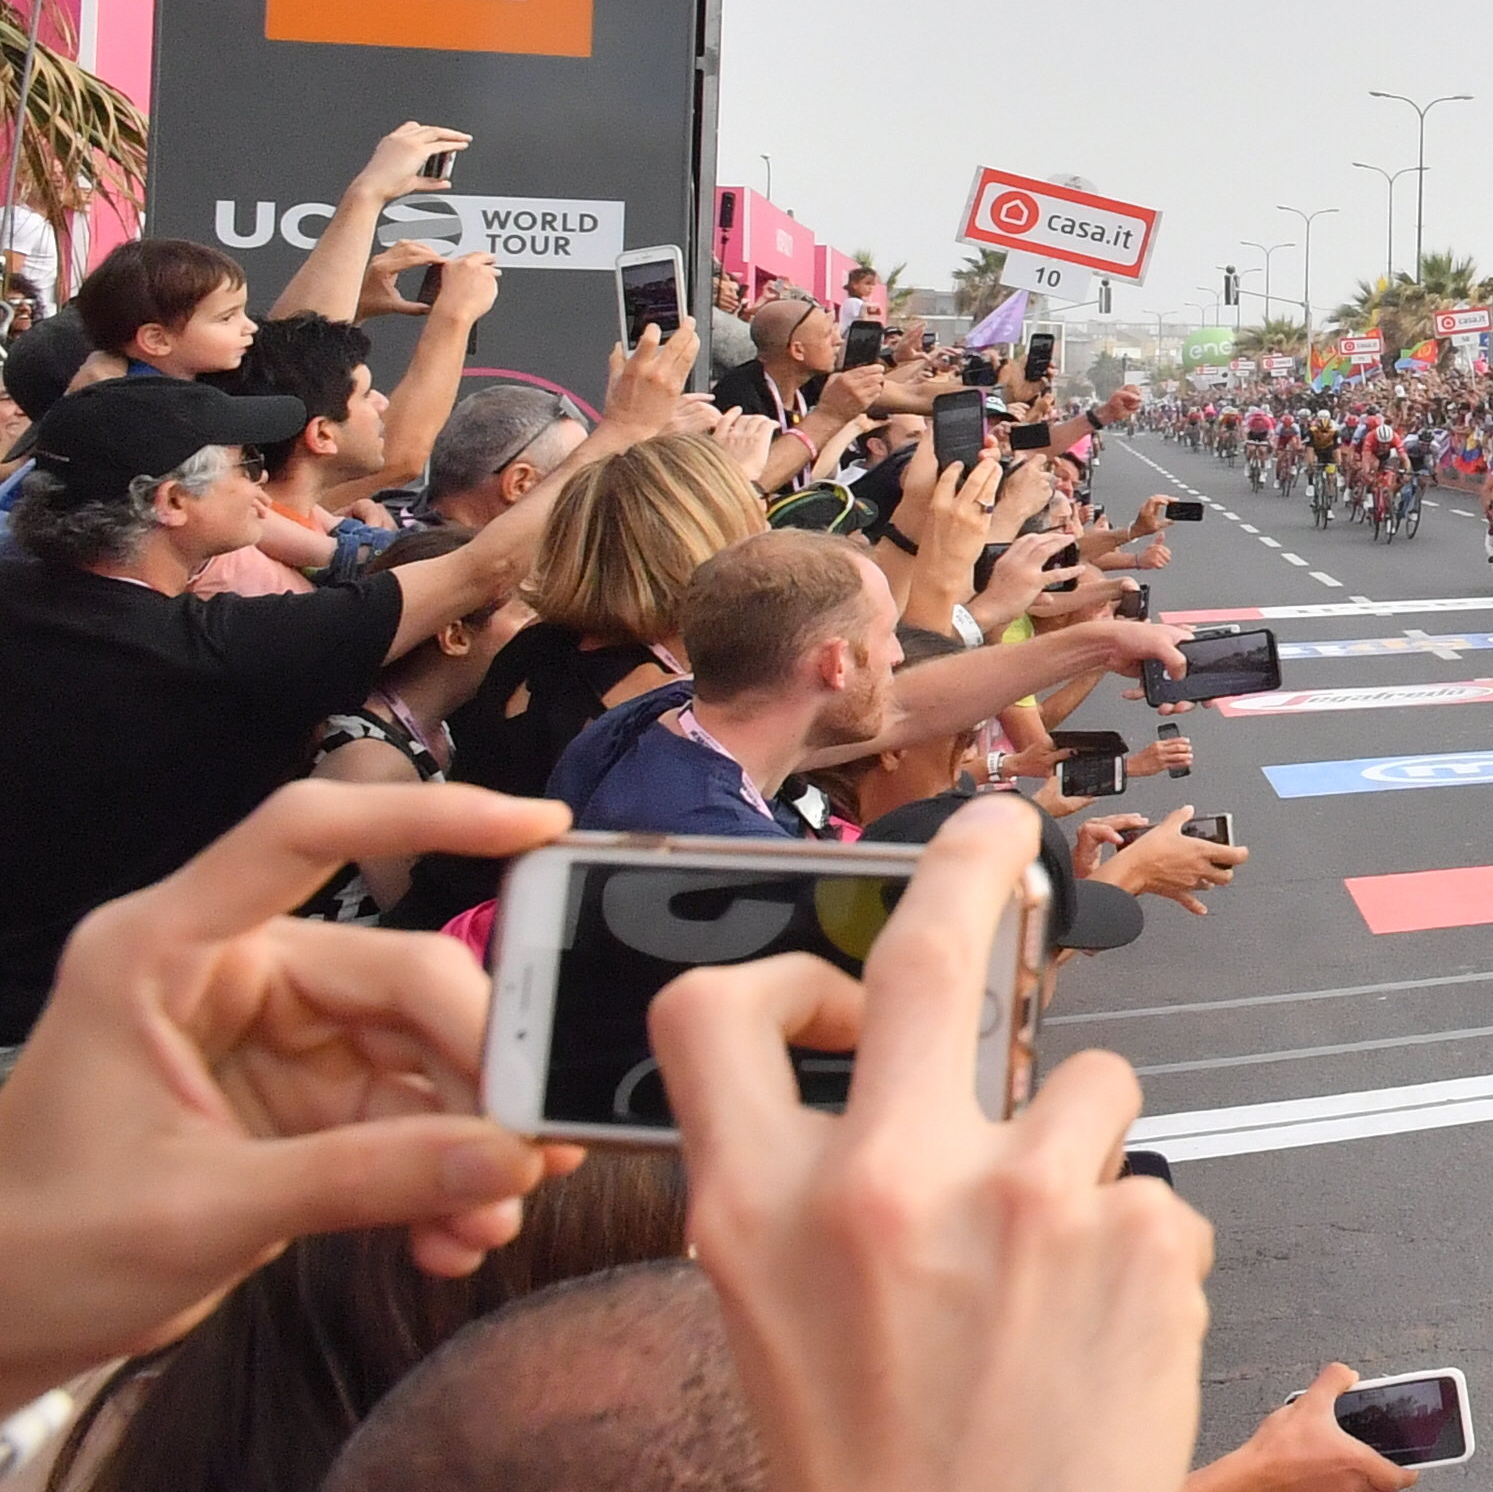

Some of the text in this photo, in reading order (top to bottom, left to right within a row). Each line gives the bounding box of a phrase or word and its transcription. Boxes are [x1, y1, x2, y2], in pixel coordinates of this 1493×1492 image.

[215, 201, 345, 249] UC
[481, 209, 598, 233] WORLD
[1047, 214, 1134, 250] casa.it
[485, 232, 571, 256] TOUR
[1035, 267, 1061, 288] 10
[1189, 340, 1233, 359] ene
